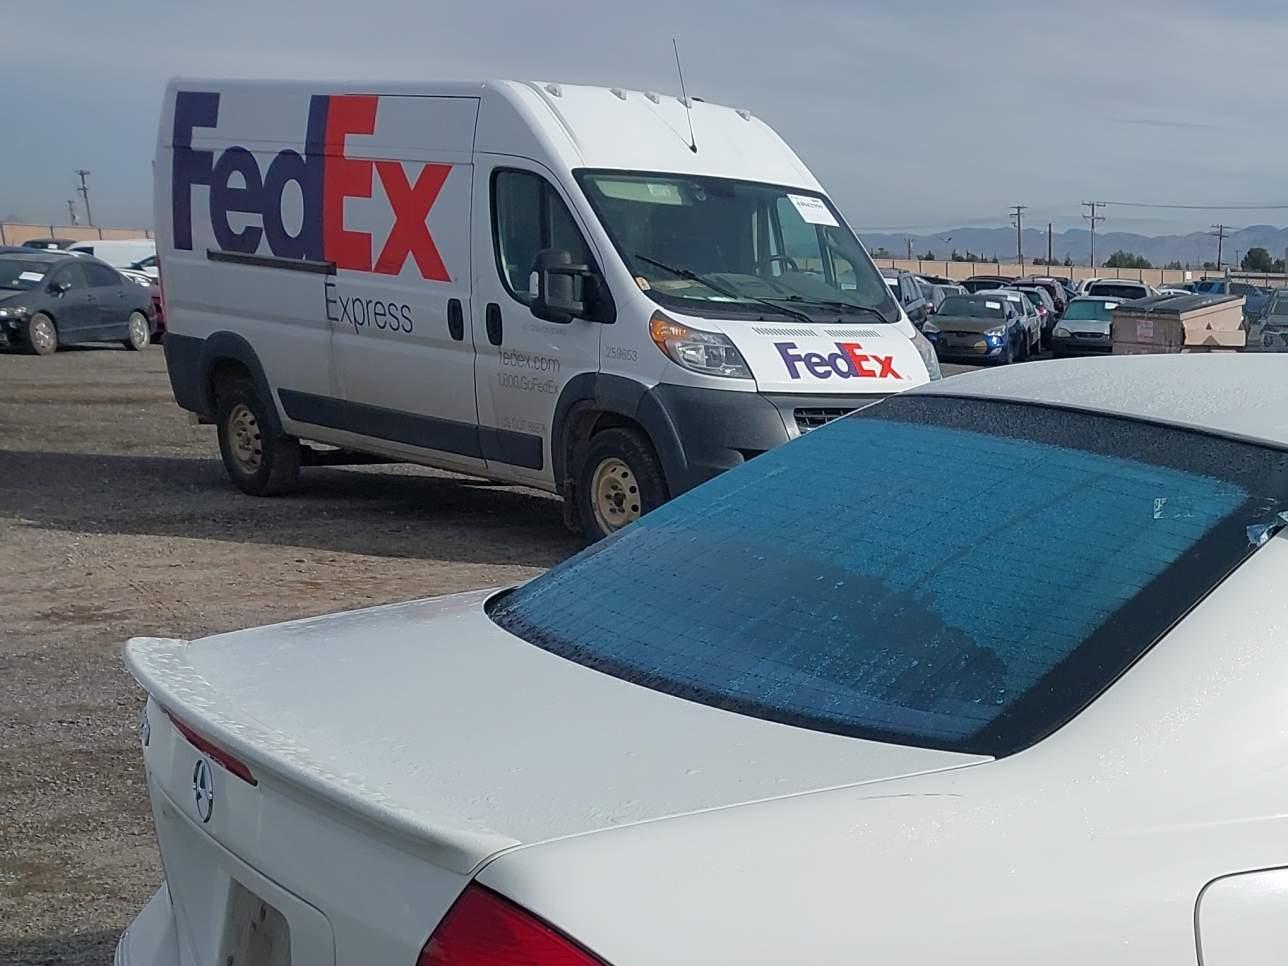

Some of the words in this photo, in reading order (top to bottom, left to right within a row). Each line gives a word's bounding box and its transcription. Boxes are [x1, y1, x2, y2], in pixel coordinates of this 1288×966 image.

[172, 91, 453, 282] FedEx
[324, 283, 414, 334] Express
[773, 342, 904, 380] FedEx
